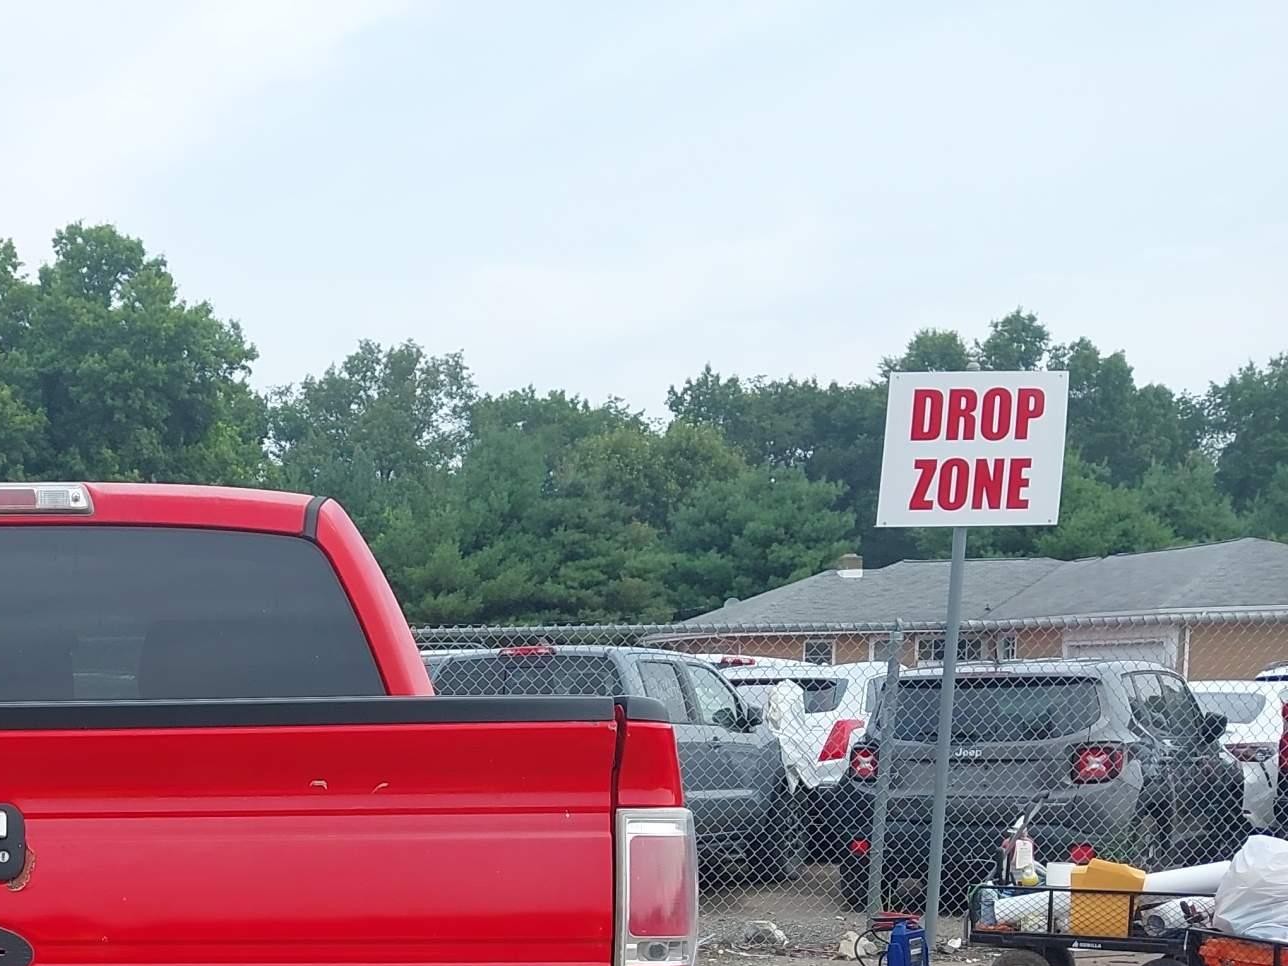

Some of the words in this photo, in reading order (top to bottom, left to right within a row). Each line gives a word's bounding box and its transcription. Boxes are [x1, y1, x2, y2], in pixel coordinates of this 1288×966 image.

[910, 387, 1045, 441] DROP
[909, 458, 1032, 511] ZONE
[954, 747, 982, 757] Jeep
